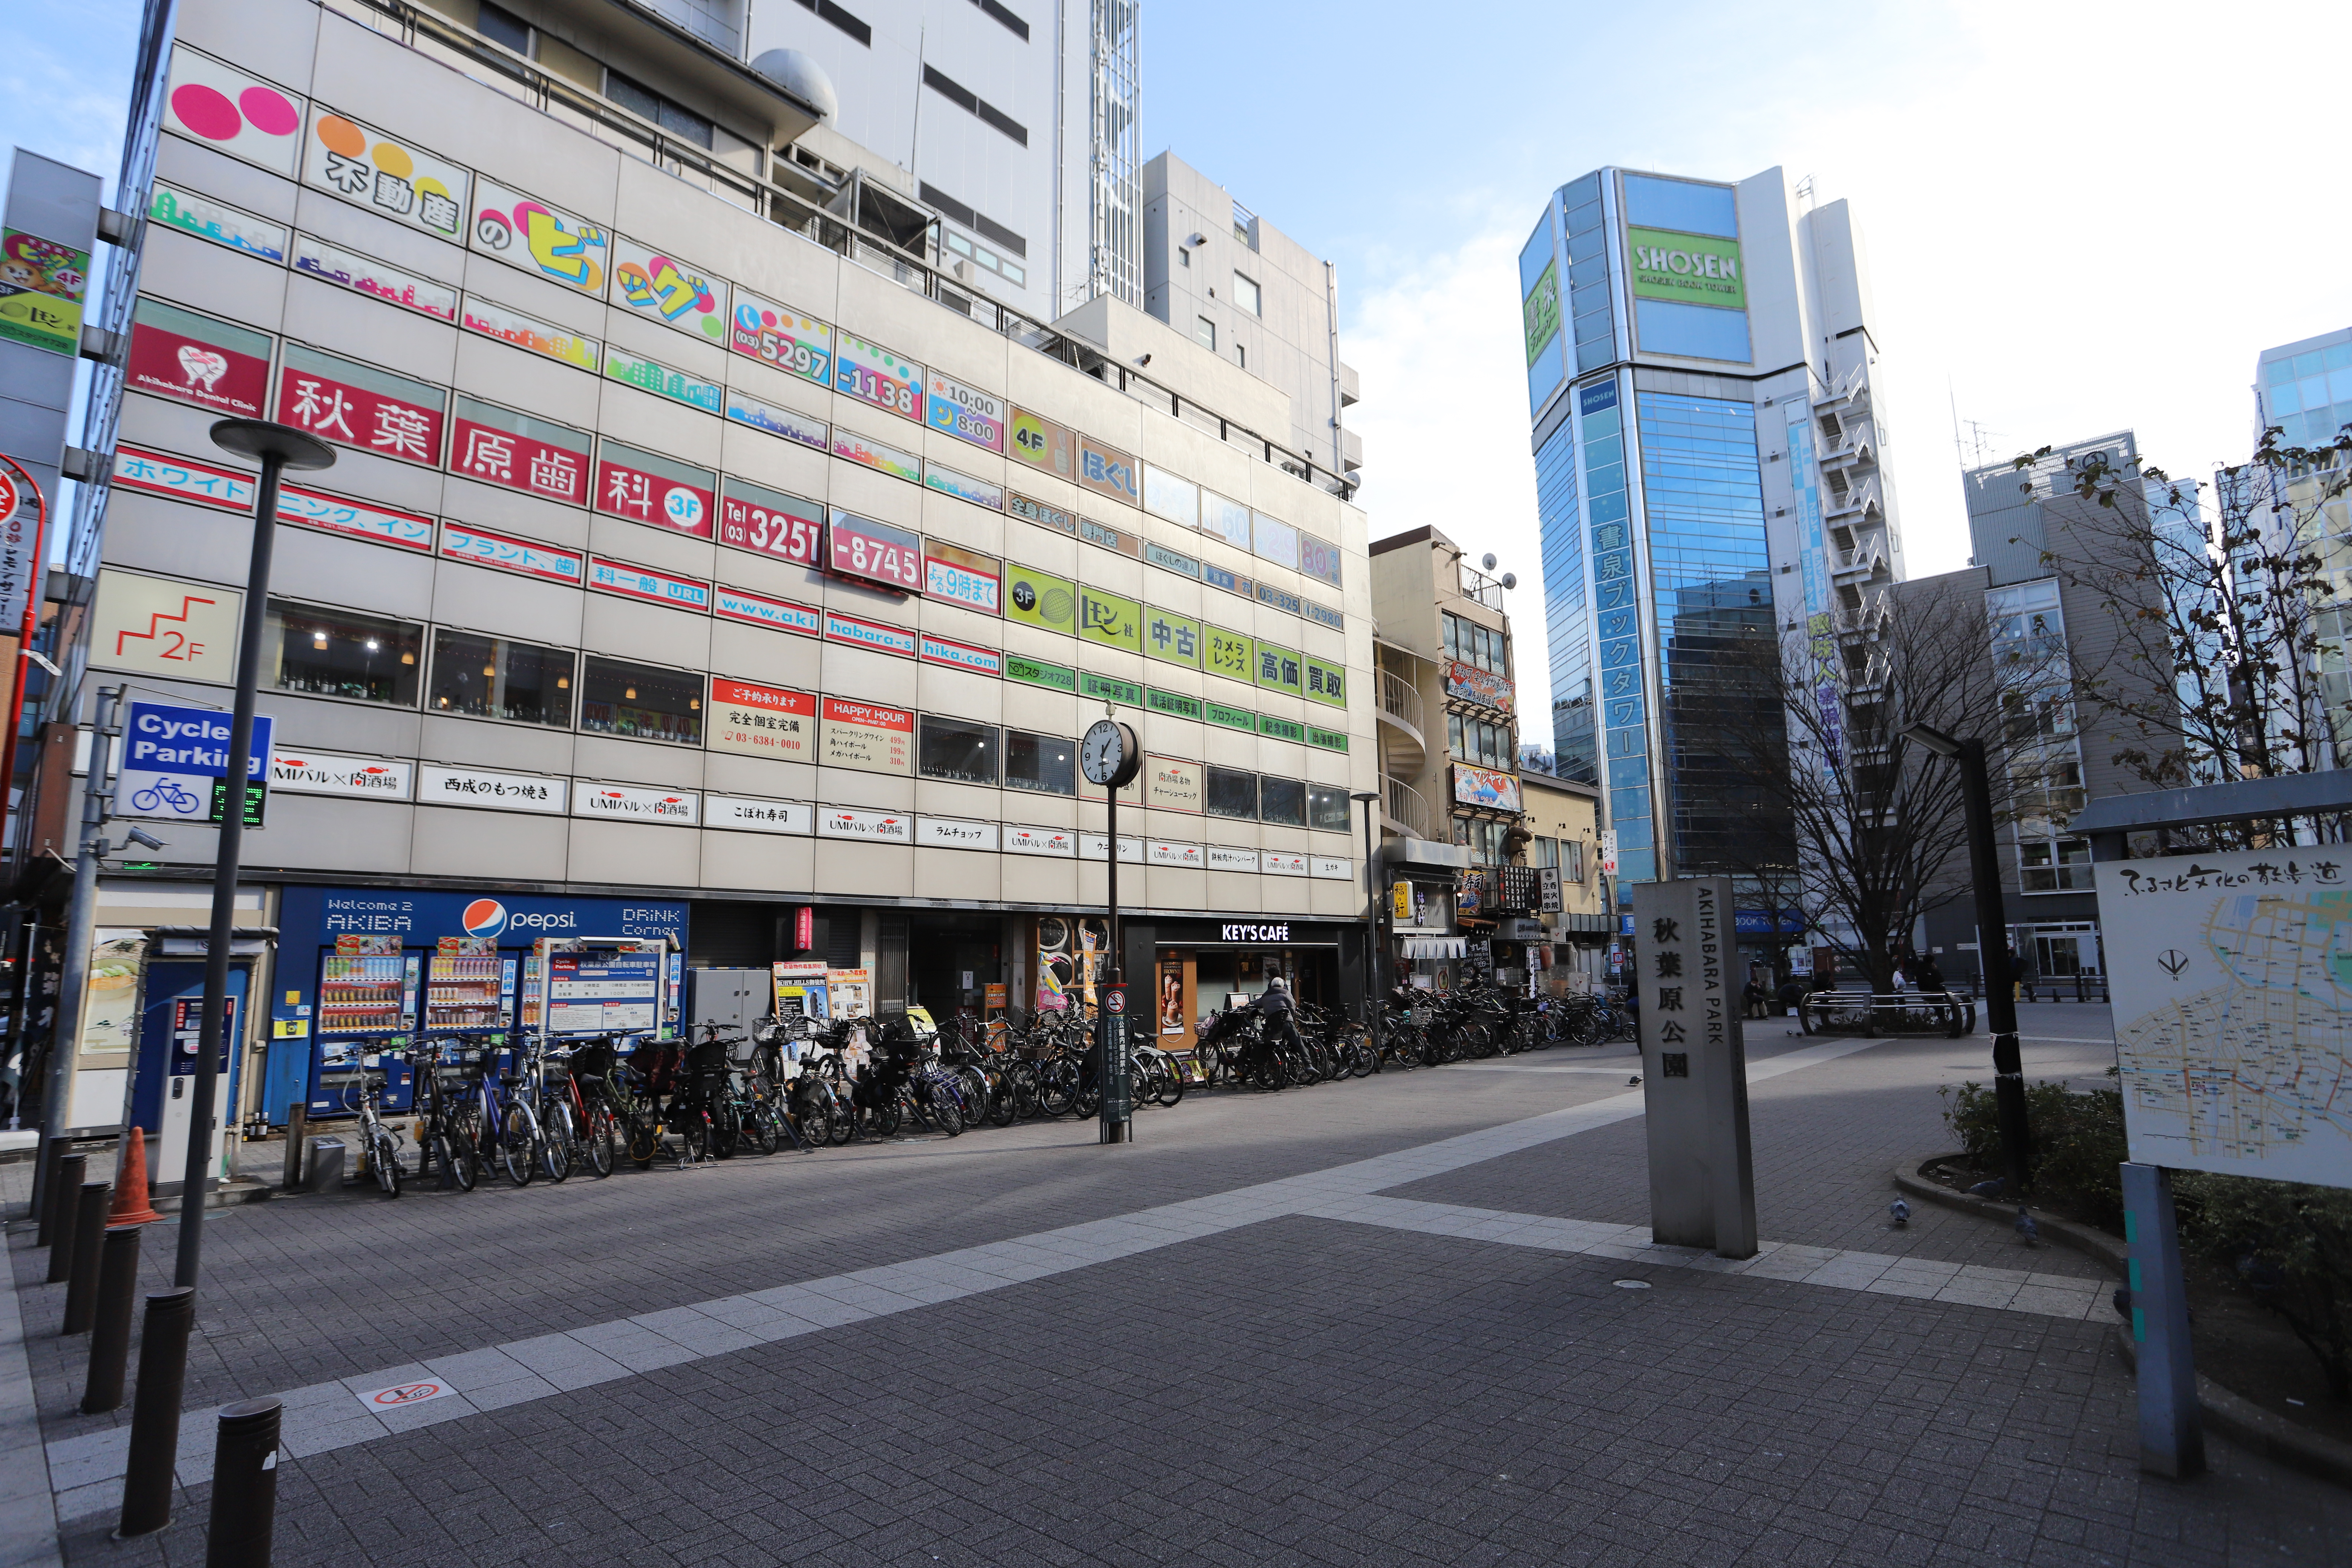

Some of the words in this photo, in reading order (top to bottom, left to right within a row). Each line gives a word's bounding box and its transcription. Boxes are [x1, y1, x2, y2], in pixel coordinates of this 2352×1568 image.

[1636, 245, 1736, 280] SHOSEN
[57, 272, 82, 285] 4F
[1639, 274, 1675, 286] SHOSEN
[1678, 279, 1702, 289] BOOK
[1706, 283, 1736, 294] TOWER
[1527, 274, 1556, 335] 書泉
[735, 329, 760, 351] (03)
[137, 373, 194, 397] Akihabara
[195, 389, 229, 406] Dental
[231, 398, 257, 413] Clinic
[949, 385, 994, 415] 10:00
[1583, 390, 1615, 407] SHOSEN
[957, 414, 994, 442] 8:00
[1788, 417, 1807, 426] SHOSEN
[1016, 428, 1045, 452] 4F
[1791, 443, 1801, 475] アイドル
[669, 494, 698, 519] 3F
[726, 501, 746, 523] Tel
[1798, 501, 1806, 539] ミリタリー
[1809, 502, 1819, 533] プロレス
[724, 522, 747, 543] (03)
[1156, 551, 1196, 574] ほぐしの達人
[928, 564, 997, 606] よる9時まで
[1213, 571, 1229, 586] 検索
[1814, 554, 1825, 603] コンピューター
[669, 585, 703, 602] URL
[1016, 587, 1033, 604] 3F
[159, 631, 205, 661] 2F
[1151, 618, 1196, 658] 中古
[1213, 636, 1245, 655] カメラ
[1598, 525, 1633, 753] 書泉ブックタワー
[1214, 652, 1245, 672] レンズ
[1024, 666, 1072, 686] スタジオ728
[732, 687, 797, 708] ご予約承ります
[1087, 678, 1135, 702] 証明写真
[1471, 691, 1496, 707] 寿司居酒屋
[834, 703, 872, 718] HAPPY
[874, 709, 905, 724] HOUR
[1150, 693, 1198, 717] 就活証明写真
[729, 711, 800, 733] 完全個室完備
[1212, 708, 1249, 726] プロフィール
[138, 714, 231, 741] Cycle
[830, 727, 885, 743] スパークリングワイン
[890, 736, 905, 746] 499円
[1098, 724, 1108, 733] 12
[1265, 721, 1297, 738] 記念撮影
[736, 732, 800, 751] 03-6384-0010
[830, 738, 867, 750] 角ハイボール
[890, 746, 905, 756] 199円
[1117, 744, 1122, 753] 3
[1312, 732, 1341, 748] 出張撮影
[134, 741, 262, 775] Parkig
[830, 750, 872, 761] メガハイボール
[890, 757, 905, 767] 310円
[1085, 752, 1090, 761] 9
[271, 766, 397, 790] MIバル×肉酒場
[1101, 773, 1107, 781] 6
[1159, 772, 1191, 786] 肉酒場名物
[1475, 769, 1502, 786] フジヤマ
[444, 778, 548, 801] 西成のもつ焼き
[1153, 787, 1198, 800] チャーシューエッグ
[1459, 792, 1468, 801] 寿司
[1470, 792, 1479, 804] 刺身
[1481, 796, 1494, 805] つまみ
[734, 805, 788, 823] こぼれ寿司
[936, 826, 983, 840] ラムチョップ
[1097, 842, 1128, 853] ウニリン
[1211, 851, 1256, 864] 鉄板肉汁ハンバーグ
[1325, 863, 1338, 872] 生ガキ
[1463, 873, 1484, 893] 寿司
[328, 899, 397, 911] Welcome
[402, 901, 413, 911] 2
[1395, 885, 1404, 915] 福の軒
[327, 914, 412, 931] AKIBA
[510, 911, 574, 932] pepsi
[622, 924, 680, 936] Corner
[1761, 916, 1792, 926] TER
[1222, 924, 1257, 941] KEY'S
[1259, 922, 1289, 942] CAFÉ
[1697, 887, 1719, 991] AKIHABARA
[1652, 917, 1688, 1078] 秋葉原公園
[1706, 997, 1723, 1044] PARK
